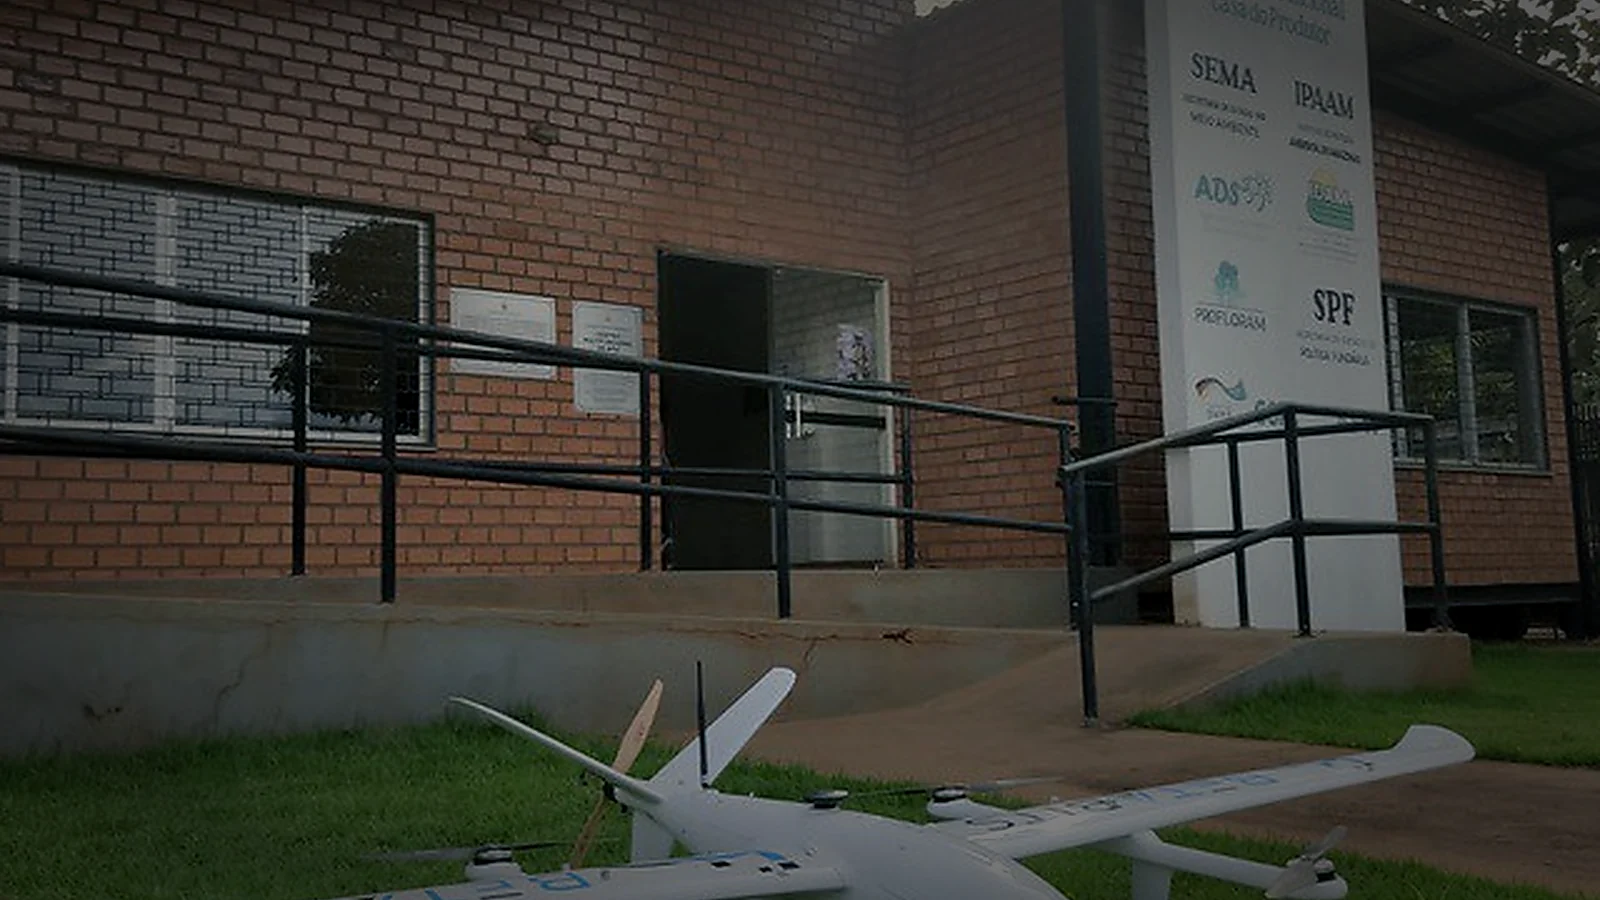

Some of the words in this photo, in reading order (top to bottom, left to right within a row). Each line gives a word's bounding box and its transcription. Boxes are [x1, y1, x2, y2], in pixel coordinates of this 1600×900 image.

[1190, 52, 1257, 94] SEMA
[1294, 79, 1355, 120] IPAAM
[1194, 174, 1239, 206] ADS
[1313, 288, 1356, 326] SPF
